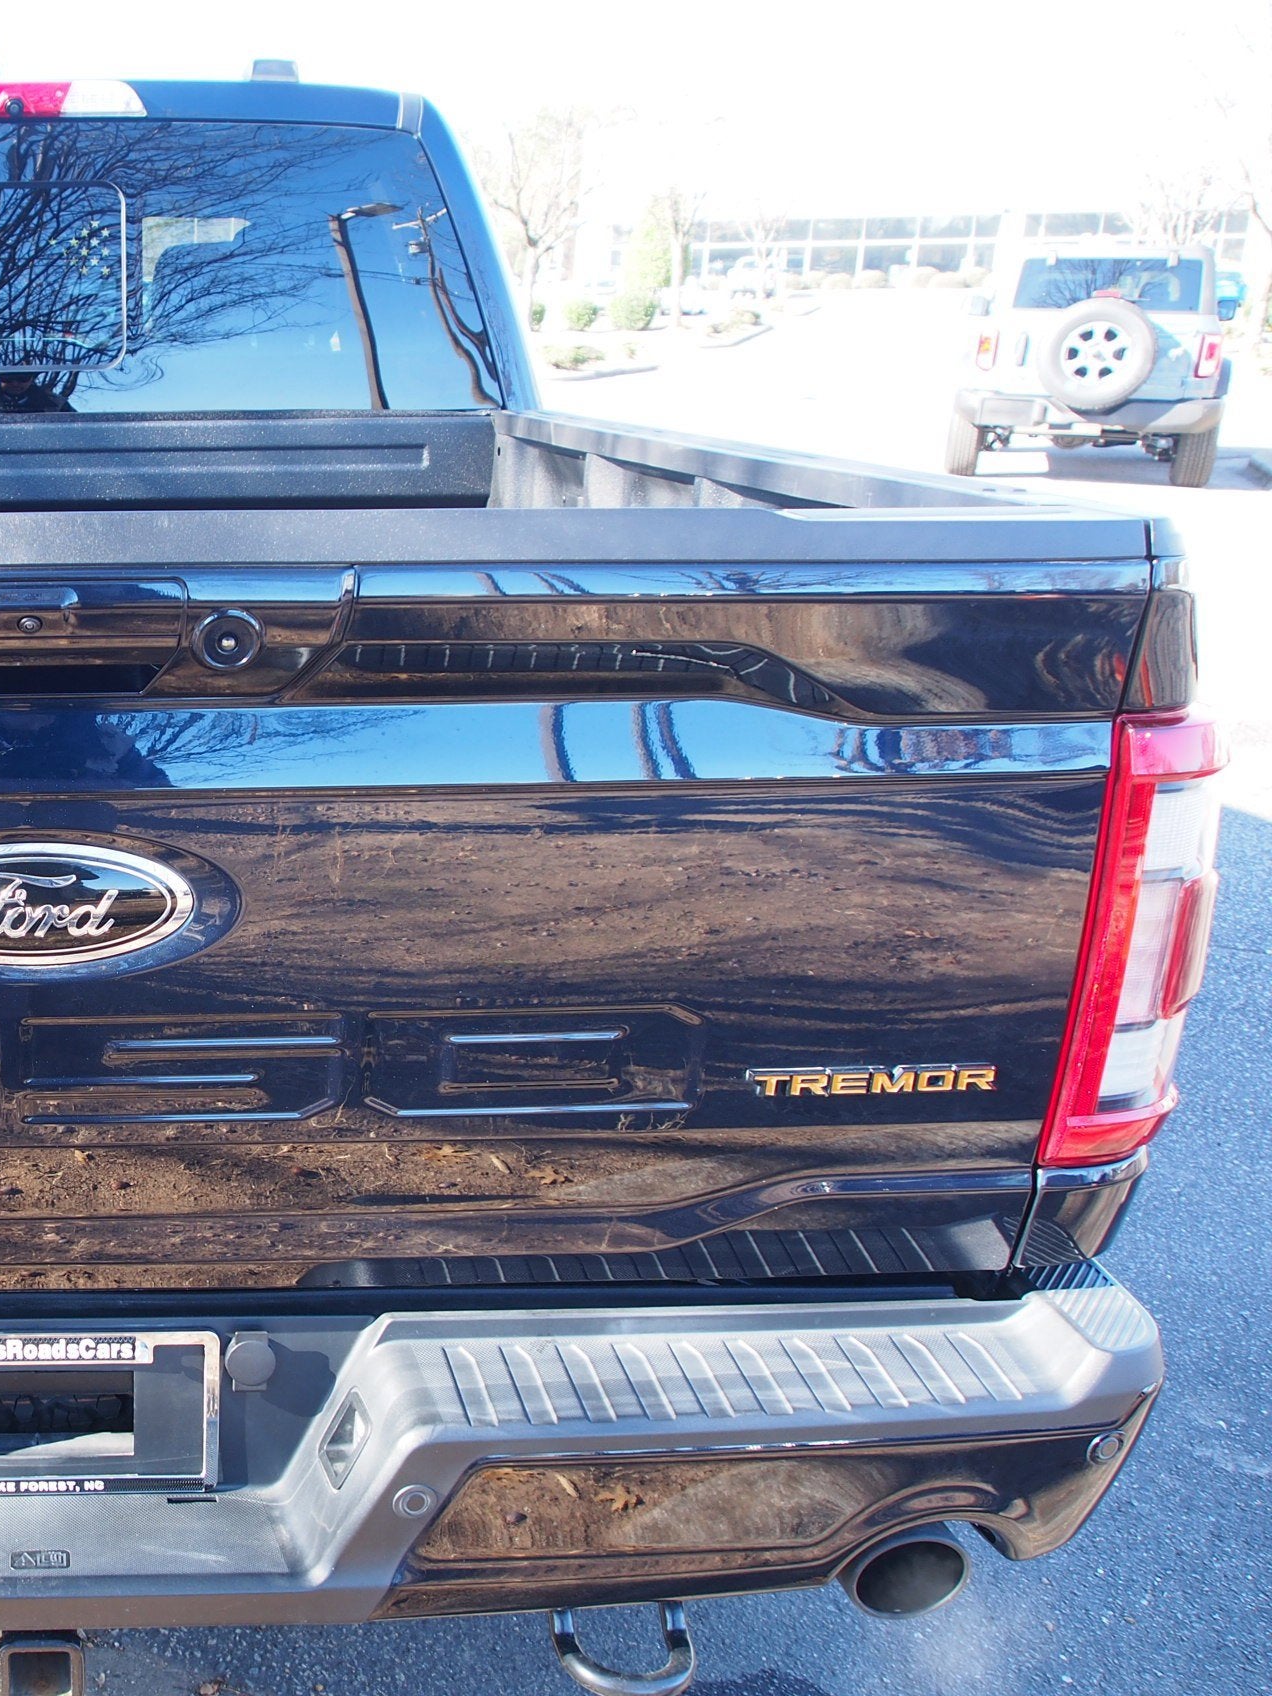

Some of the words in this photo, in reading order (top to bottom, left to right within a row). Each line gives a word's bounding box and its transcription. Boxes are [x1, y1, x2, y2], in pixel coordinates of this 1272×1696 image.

[746, 1063, 998, 1098] TREMOR
[20, 1480, 80, 1493] FOREST,
[84, 1480, 105, 1491] NC
